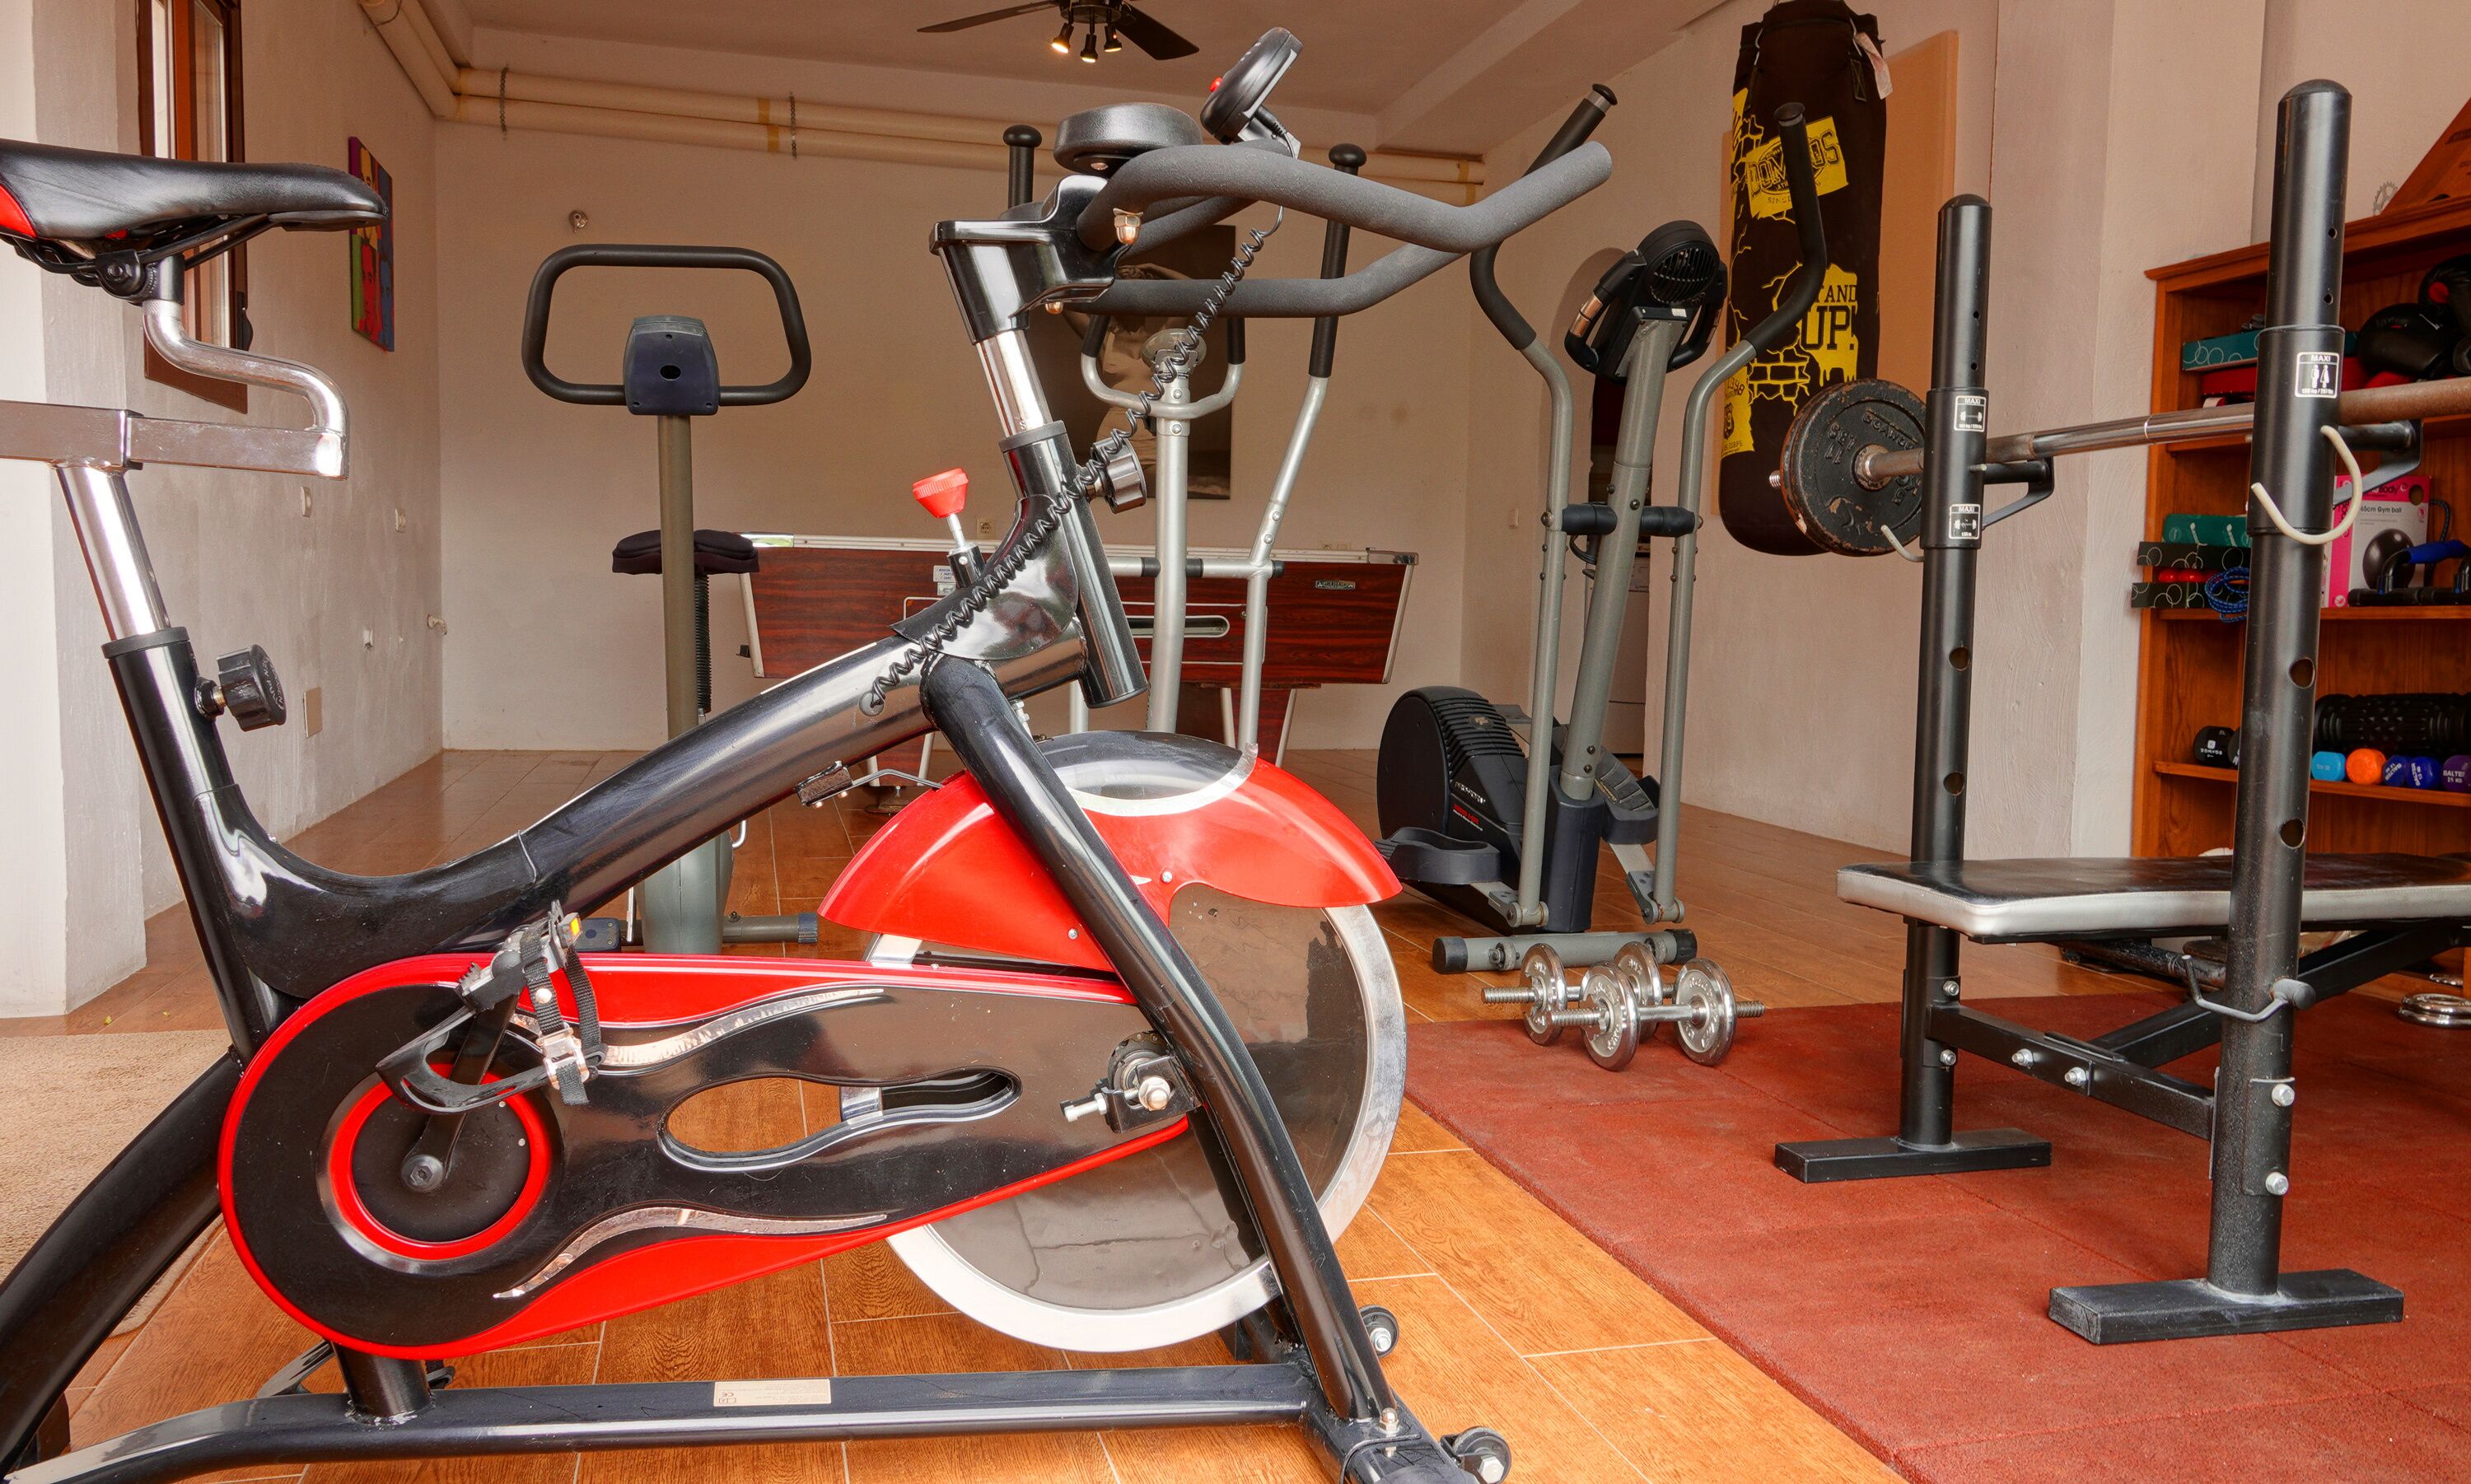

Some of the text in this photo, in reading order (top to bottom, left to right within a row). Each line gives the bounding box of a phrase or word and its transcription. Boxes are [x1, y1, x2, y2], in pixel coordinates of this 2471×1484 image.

[1749, 131, 1839, 197] DOMOS
[1801, 305, 1857, 351] UP!
[2310, 354, 2331, 362] MAXI
[2377, 506, 2390, 514] Gym
